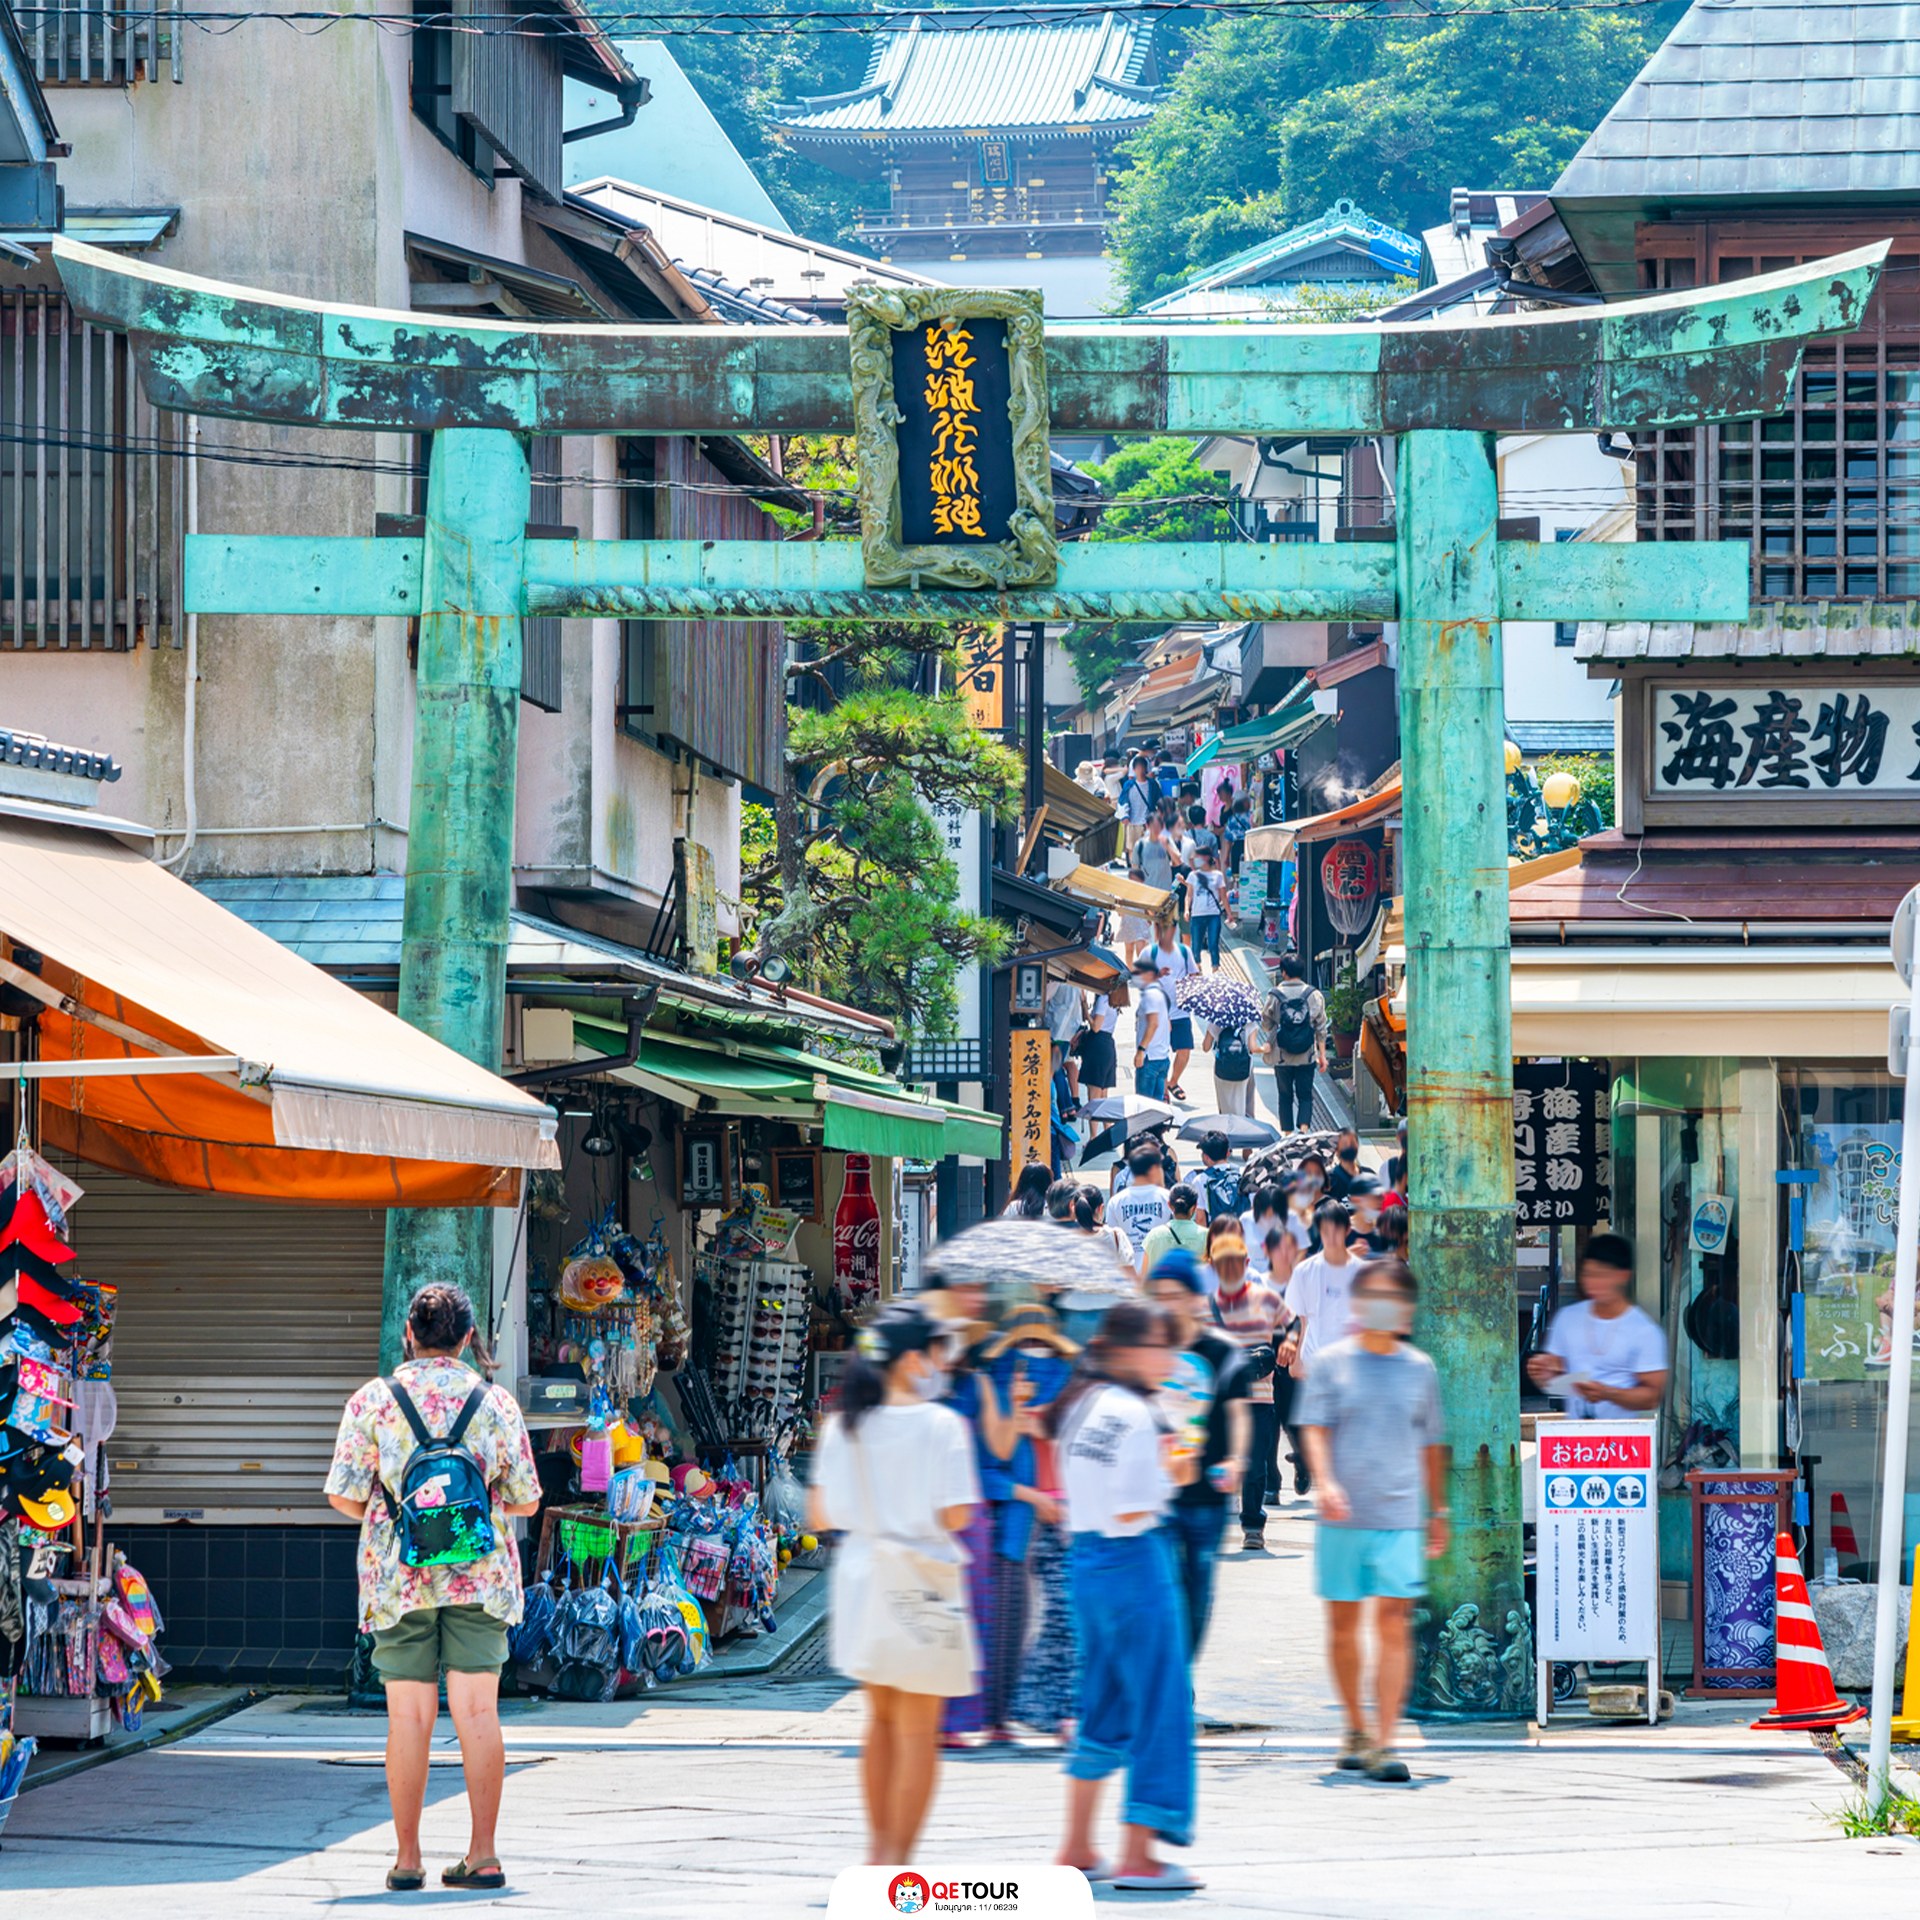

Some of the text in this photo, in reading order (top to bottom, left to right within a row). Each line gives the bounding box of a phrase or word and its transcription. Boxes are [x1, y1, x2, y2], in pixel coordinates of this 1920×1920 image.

[1661, 690, 1920, 789] 海産物
[1552, 1442, 1639, 1463] おねがい
